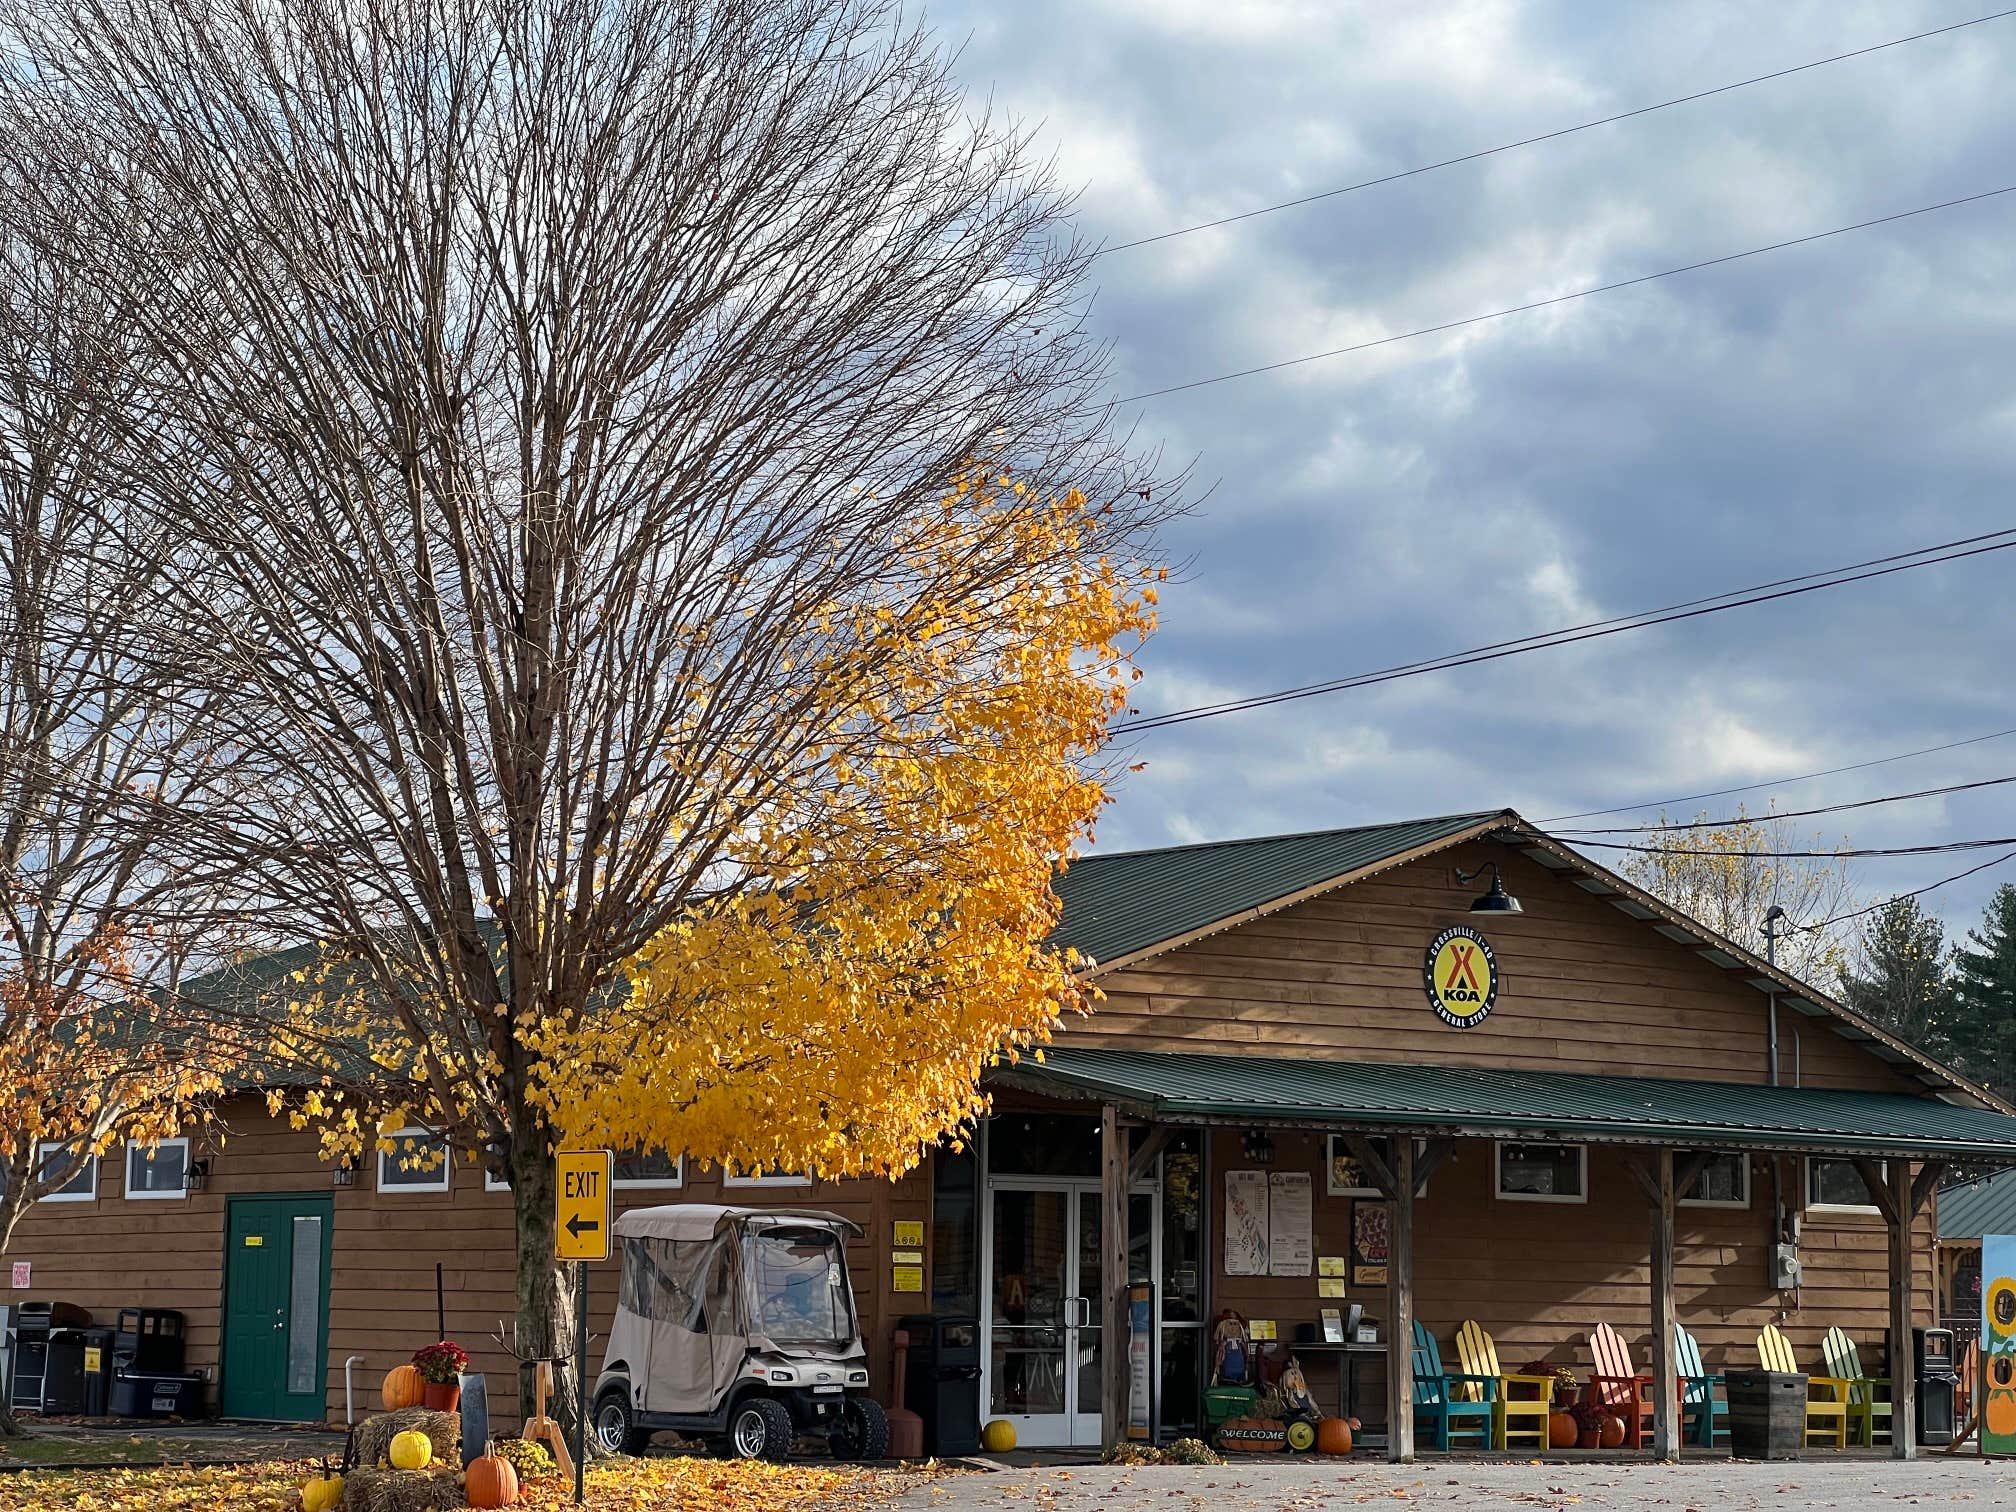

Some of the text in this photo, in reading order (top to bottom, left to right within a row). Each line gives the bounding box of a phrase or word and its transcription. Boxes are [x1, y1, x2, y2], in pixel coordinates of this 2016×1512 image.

[1444, 990, 1480, 1002] KOA
[1433, 1000, 1492, 1027] GENERAL STORE
[565, 1171, 599, 1198] EXIT
[1221, 1429, 1285, 1440] WELCOME
